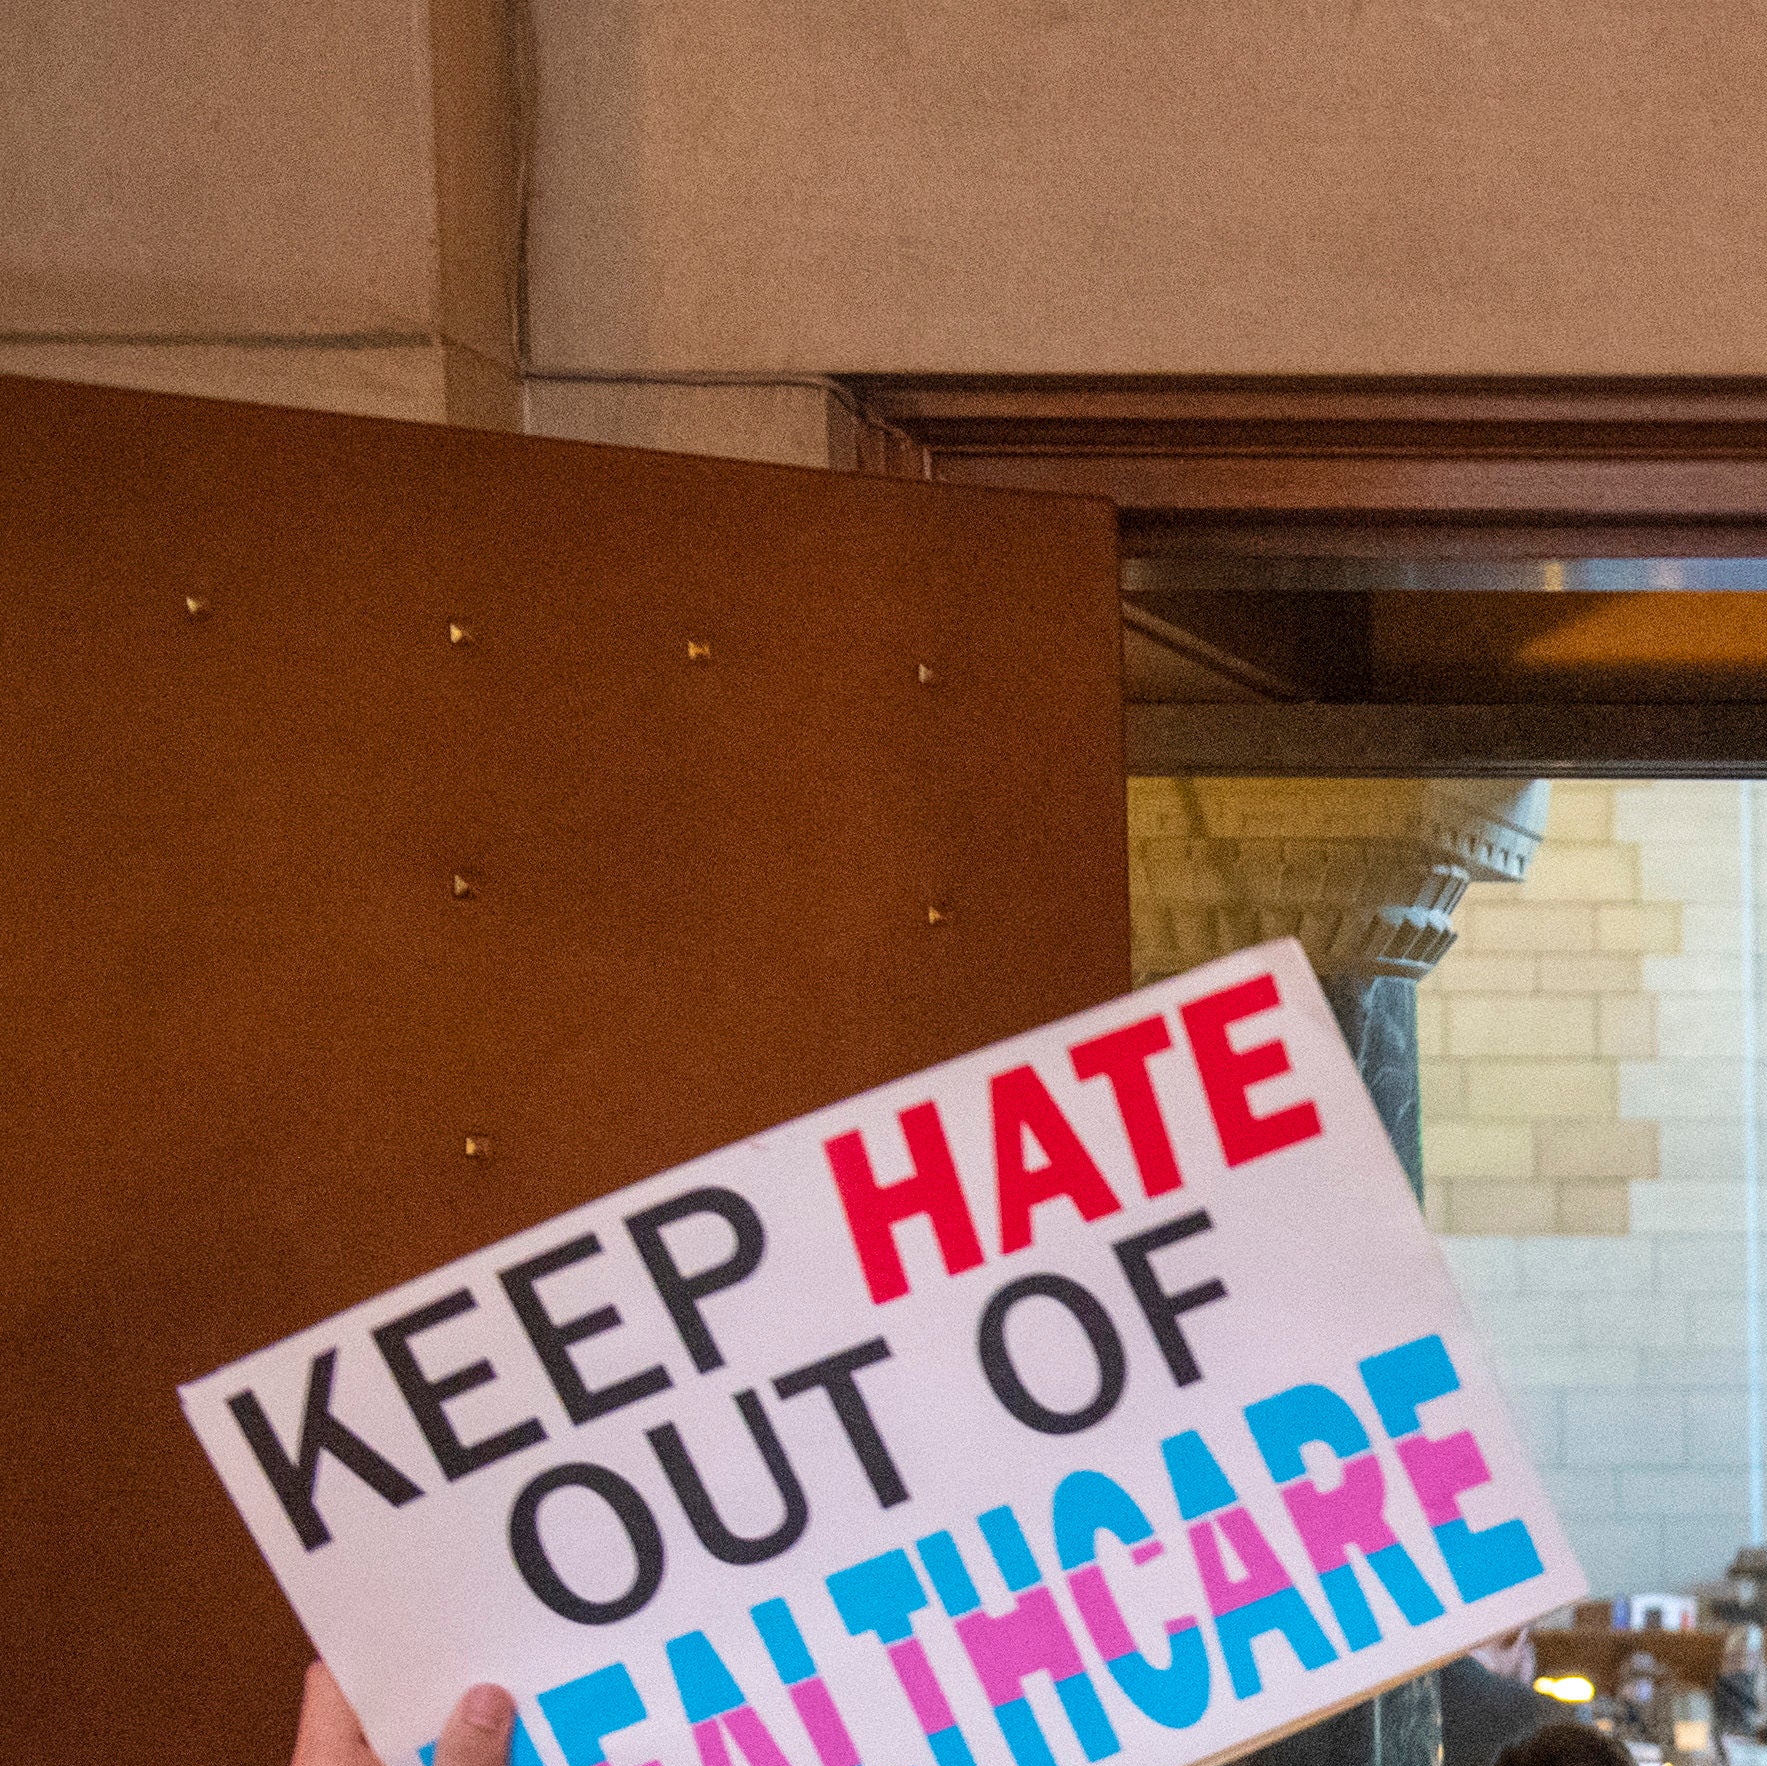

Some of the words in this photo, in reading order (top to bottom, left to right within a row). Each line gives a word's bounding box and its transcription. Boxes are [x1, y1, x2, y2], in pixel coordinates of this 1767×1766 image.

[226, 1187, 766, 1552] KEEP
[824, 973, 1322, 1305] HATE
[508, 1337, 909, 1626] OUT
[977, 1210, 1227, 1436] OF
